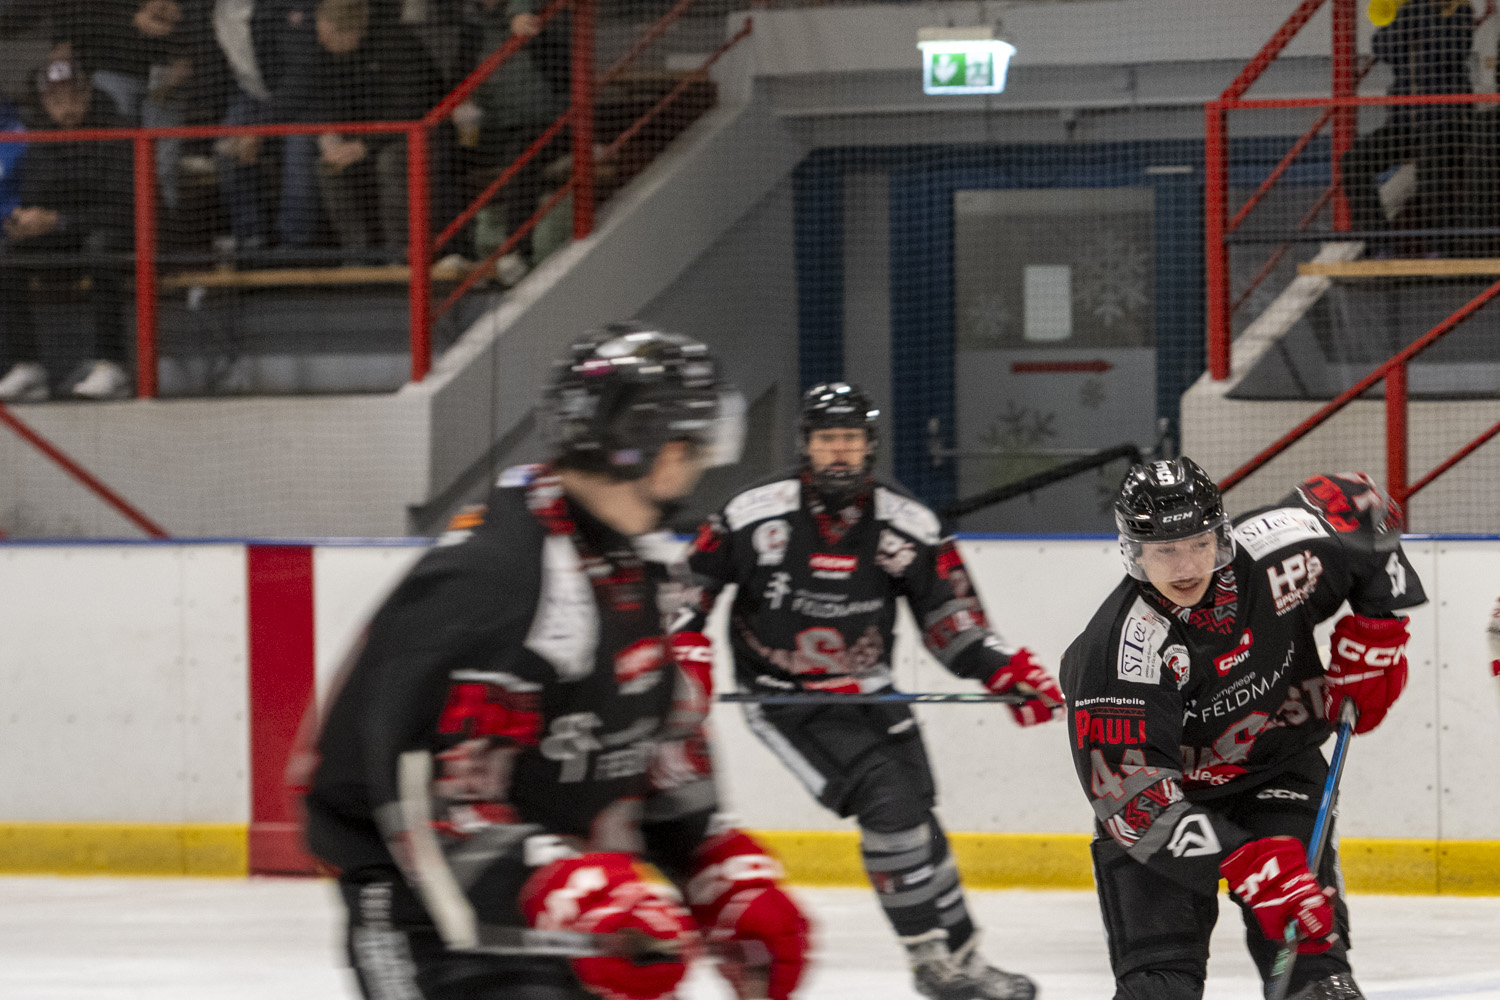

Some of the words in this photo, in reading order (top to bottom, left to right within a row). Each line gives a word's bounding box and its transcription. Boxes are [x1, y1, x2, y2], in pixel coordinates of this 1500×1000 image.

[1163, 511, 1194, 524] CCM
[1121, 616, 1148, 677] SiTec
[1202, 640, 1296, 723] FELDMANN
[1075, 697, 1146, 708] Betonfertigteile
[1075, 709, 1147, 750] PAULI
